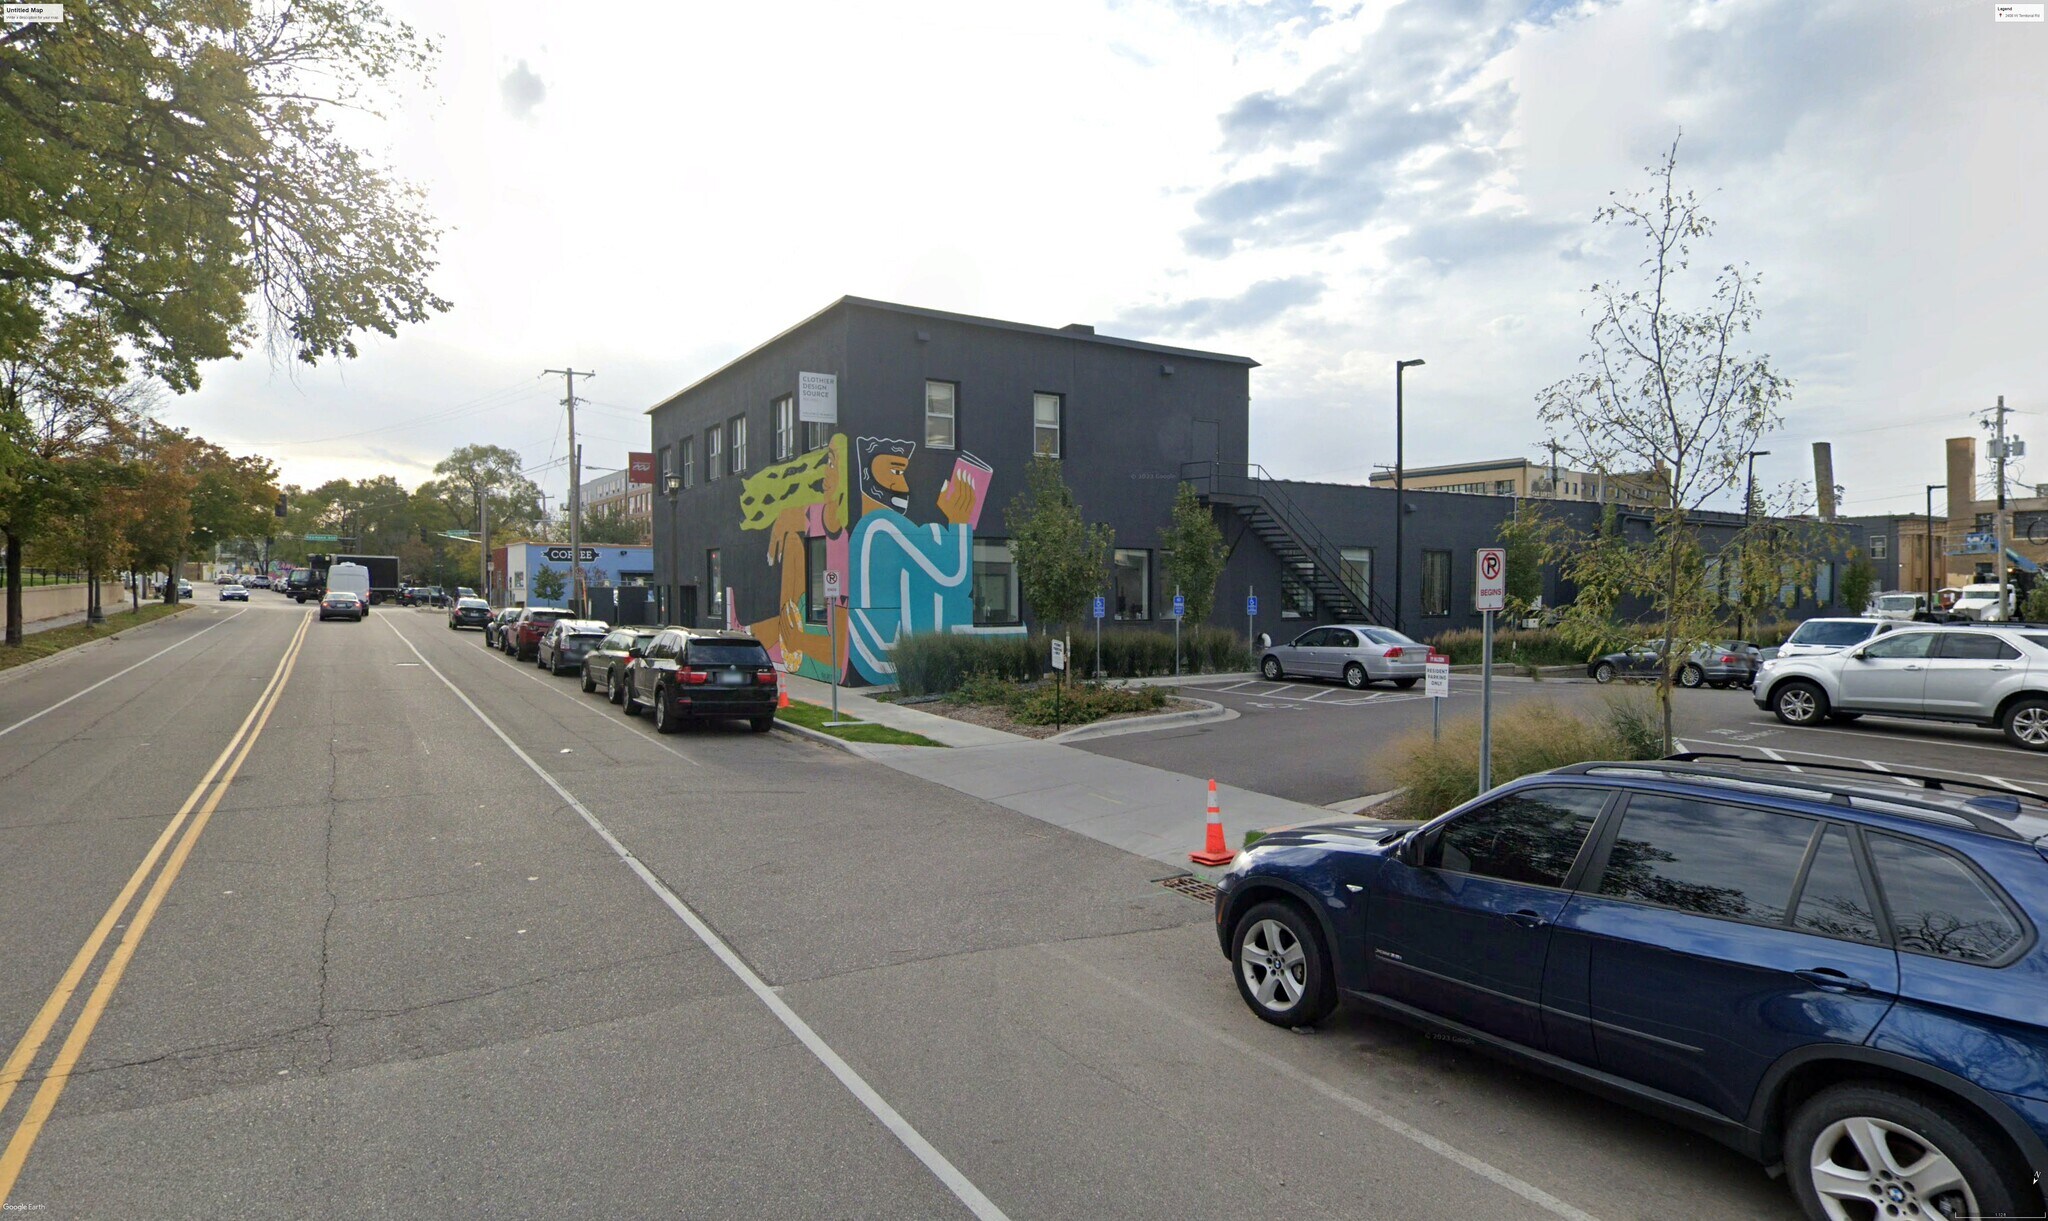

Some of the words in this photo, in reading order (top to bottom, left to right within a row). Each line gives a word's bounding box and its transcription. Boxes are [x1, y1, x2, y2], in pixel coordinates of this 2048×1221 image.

[802, 376, 835, 385] CLOTHIER
[802, 383, 827, 391] DESIGN
[802, 390, 829, 398] SOURCE
[551, 550, 593, 560] COFEE
[1480, 588, 1502, 597] BEGINS
